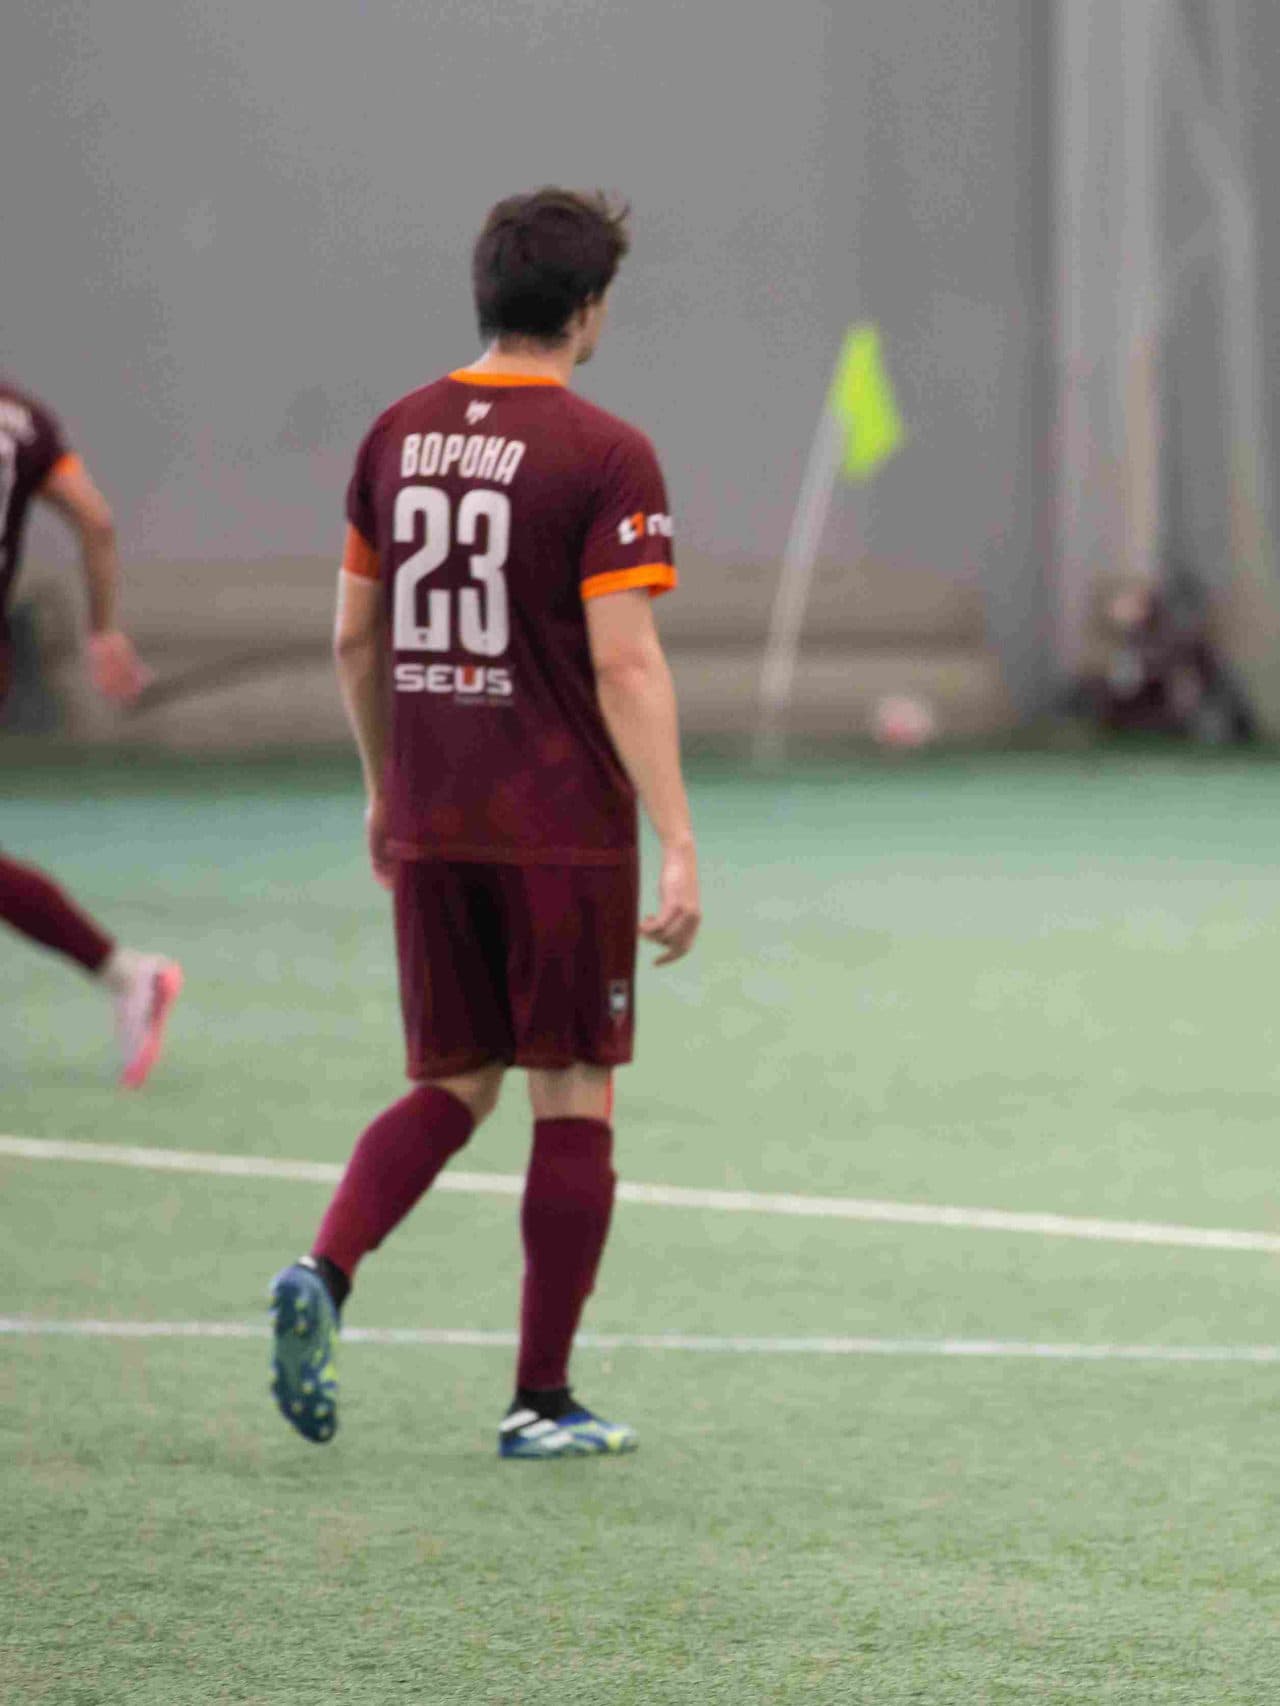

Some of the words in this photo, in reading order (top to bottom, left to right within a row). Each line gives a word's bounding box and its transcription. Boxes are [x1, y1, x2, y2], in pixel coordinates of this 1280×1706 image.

[401, 432, 526, 485] ВОРОНА
[394, 485, 511, 657] 23
[394, 663, 513, 696] SEUS
